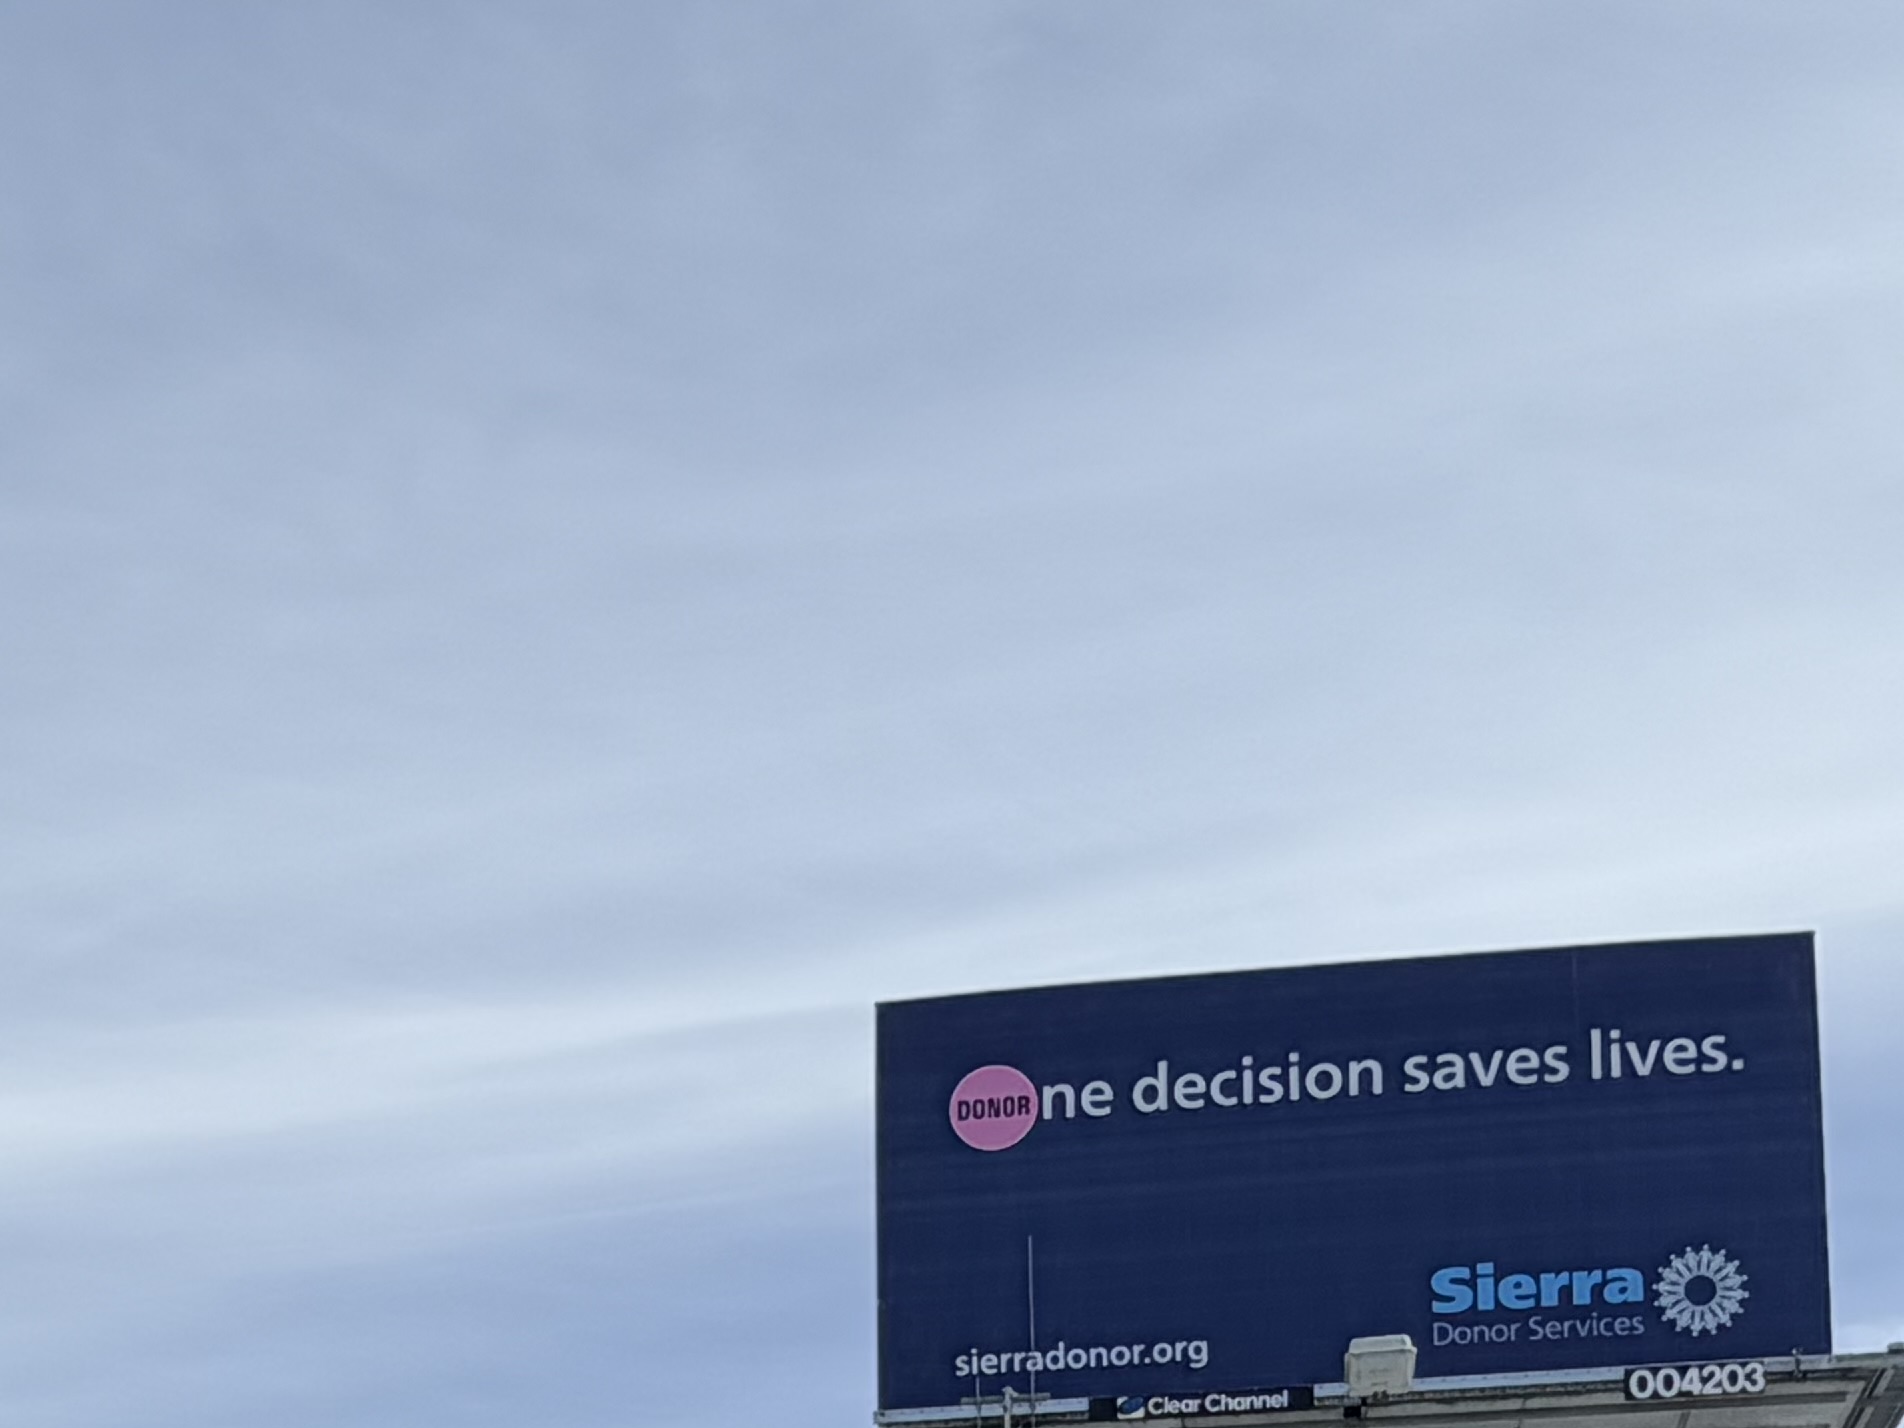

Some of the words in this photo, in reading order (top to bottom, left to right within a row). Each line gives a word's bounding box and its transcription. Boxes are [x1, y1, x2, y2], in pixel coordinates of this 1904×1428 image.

[956, 1094, 1031, 1121] DONOR
[1132, 1051, 1384, 1113] decision
[1403, 1044, 1570, 1093] saves
[1590, 1028, 1745, 1080] lives.
[1430, 1261, 1645, 1314] Sierra
[1432, 1321, 1522, 1347] Donor
[1528, 1312, 1645, 1341] Services
[955, 1339, 1209, 1377] sierradonor.org
[1628, 1362, 1767, 1400] 004203
[1147, 1394, 1202, 1416] Clear
[1204, 1389, 1289, 1413] Channel
